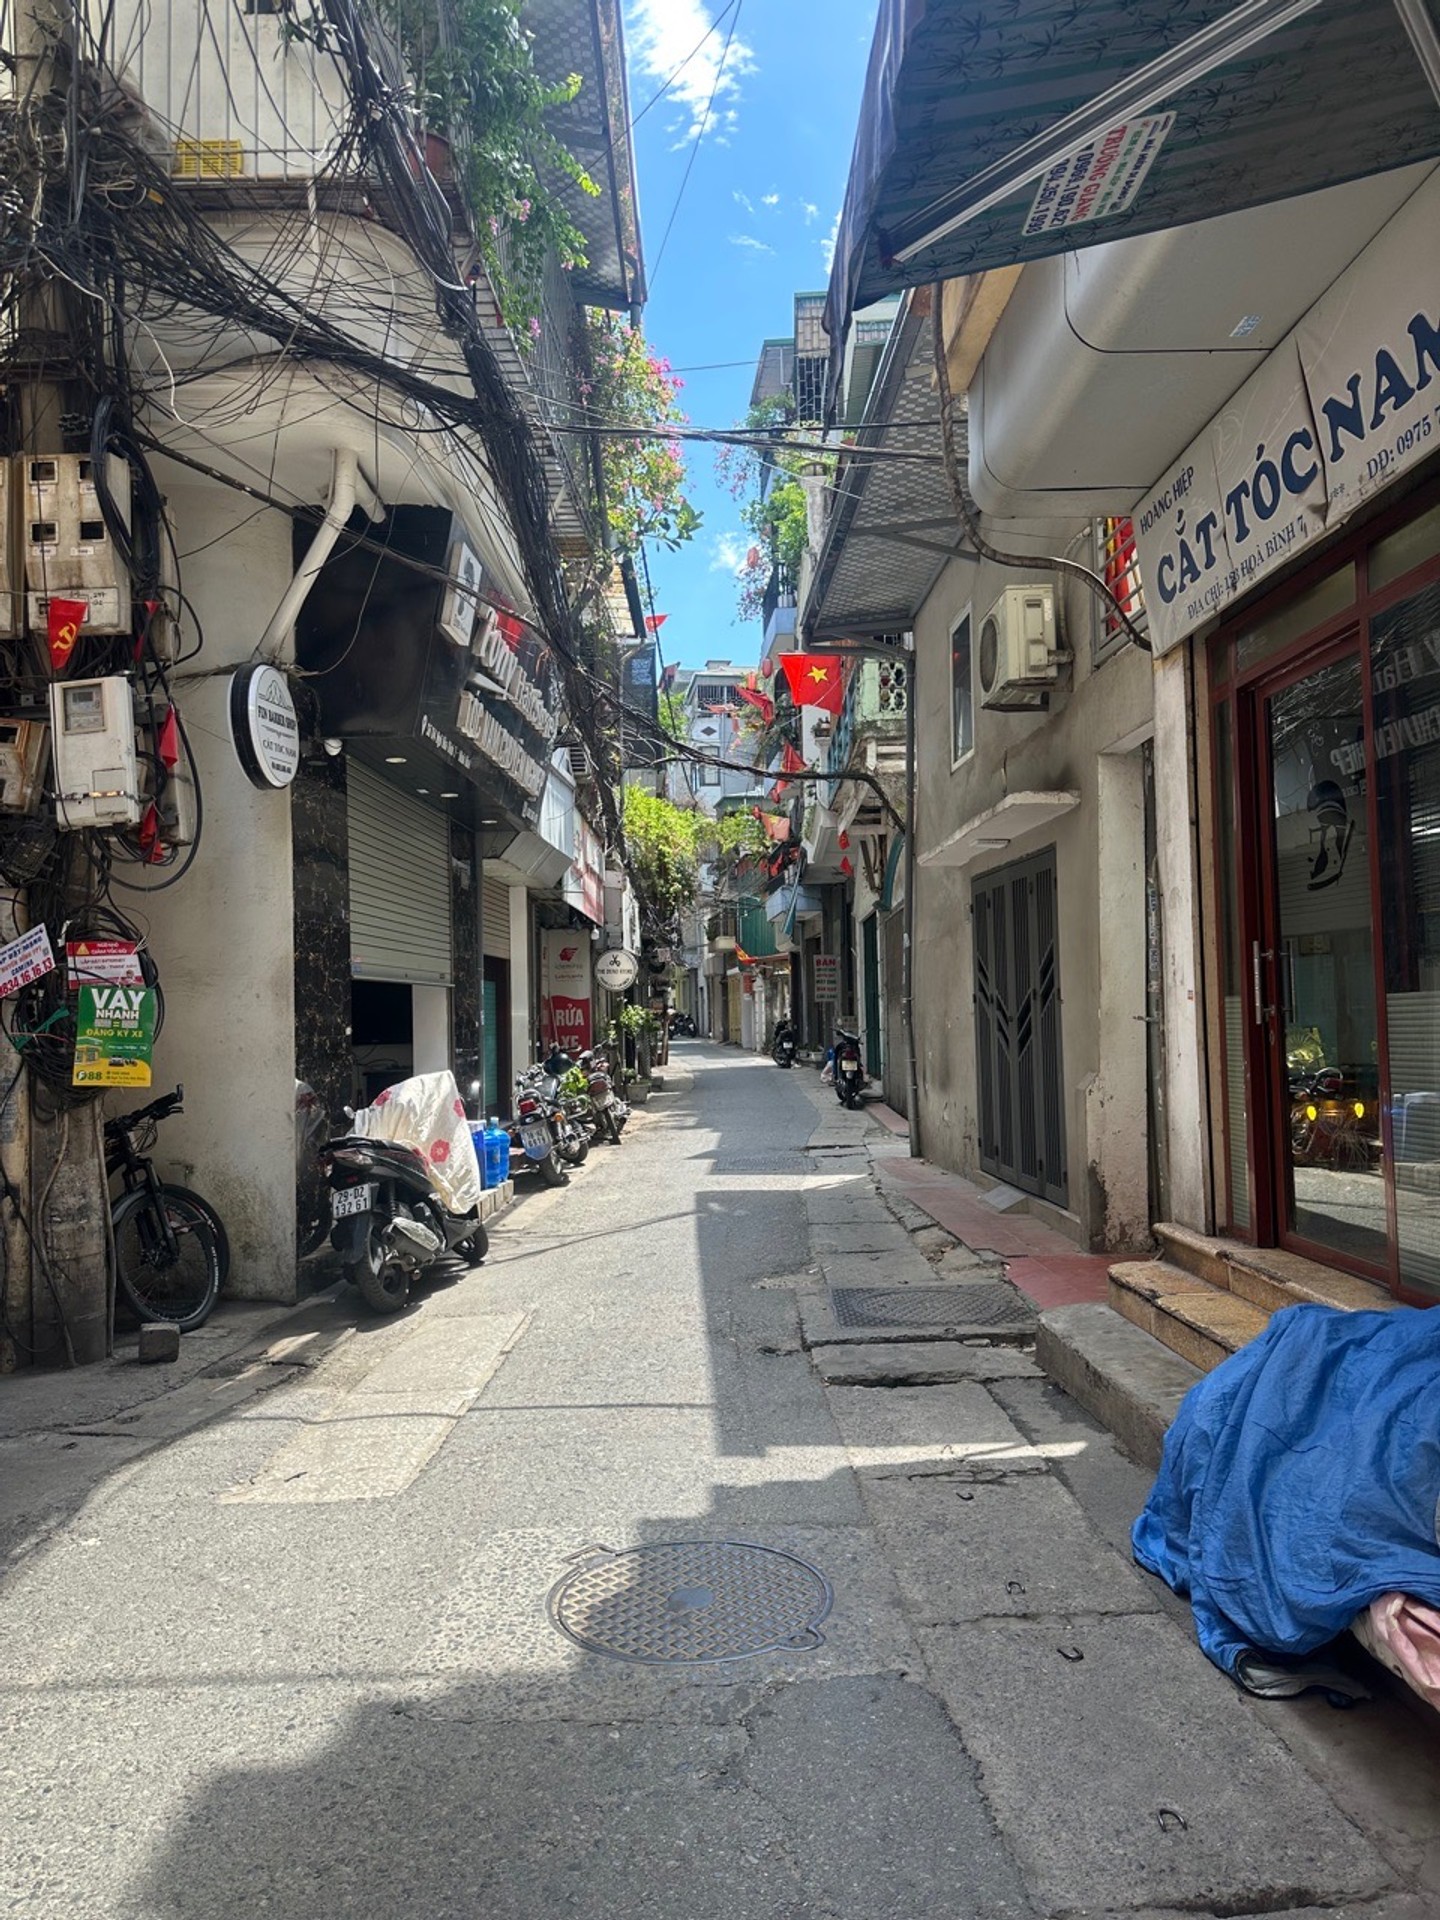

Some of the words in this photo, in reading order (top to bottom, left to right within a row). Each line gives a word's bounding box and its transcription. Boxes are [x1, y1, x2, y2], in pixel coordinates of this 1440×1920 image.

[1088, 125, 1128, 182] TRƯỜNG
[1070, 182, 1101, 222] GIANG
[1140, 490, 1174, 535] HOÀNG
[1173, 466, 1195, 501] HIỆP
[1157, 507, 1218, 604] CẮT
[1226, 427, 1318, 544] TÓC
[1187, 599, 1205, 621] ĐỊA
[1204, 577, 1225, 609] CHỈ:
[1241, 543, 1265, 579] HOÀ
[1266, 523, 1297, 557] BÌNH
[1366, 447, 1396, 481] DĐ:
[1396, 418, 1433, 455] 0975
[91, 988, 147, 1011] VAY
[96, 1009, 139, 1019] NHANH
[556, 1003, 584, 1026] RỬA
[86, 1027, 114, 1037] ĐĂNG
[131, 1030, 144, 1038] XE
[560, 1034, 579, 1049] XE
